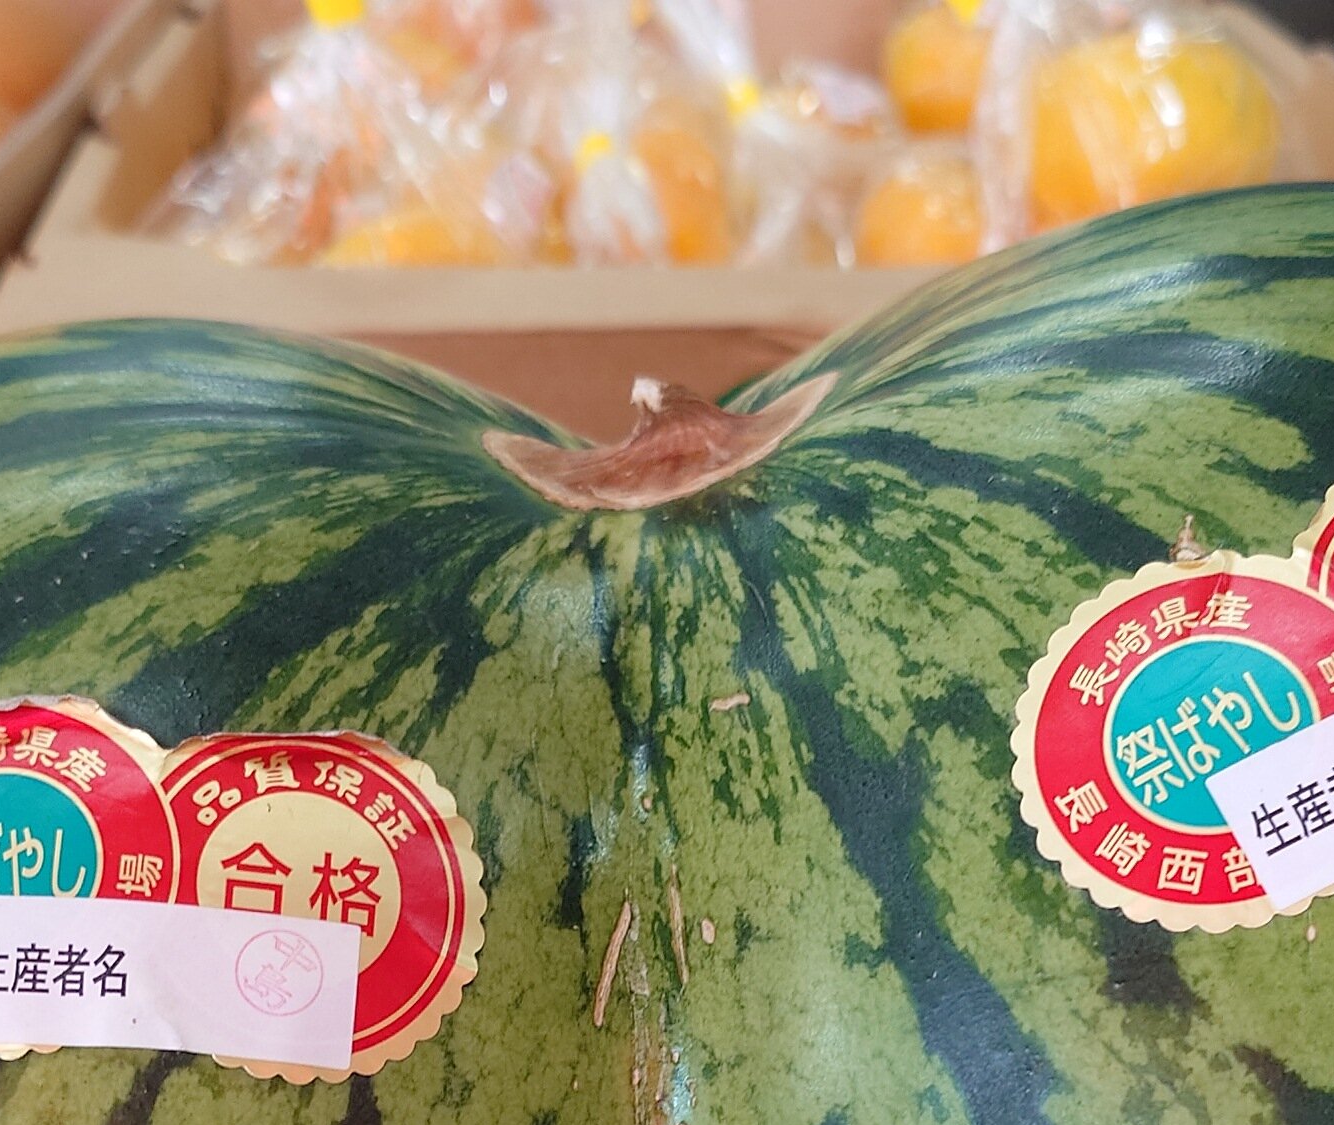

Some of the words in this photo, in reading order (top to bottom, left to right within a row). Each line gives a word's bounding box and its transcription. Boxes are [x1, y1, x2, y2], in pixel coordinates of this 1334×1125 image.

[1070, 591, 1253, 706] 長崎県産
[1116, 672, 1300, 806] 祭ばやし
[193, 757, 417, 851] 品質保証
[221, 842, 383, 937] 合格
